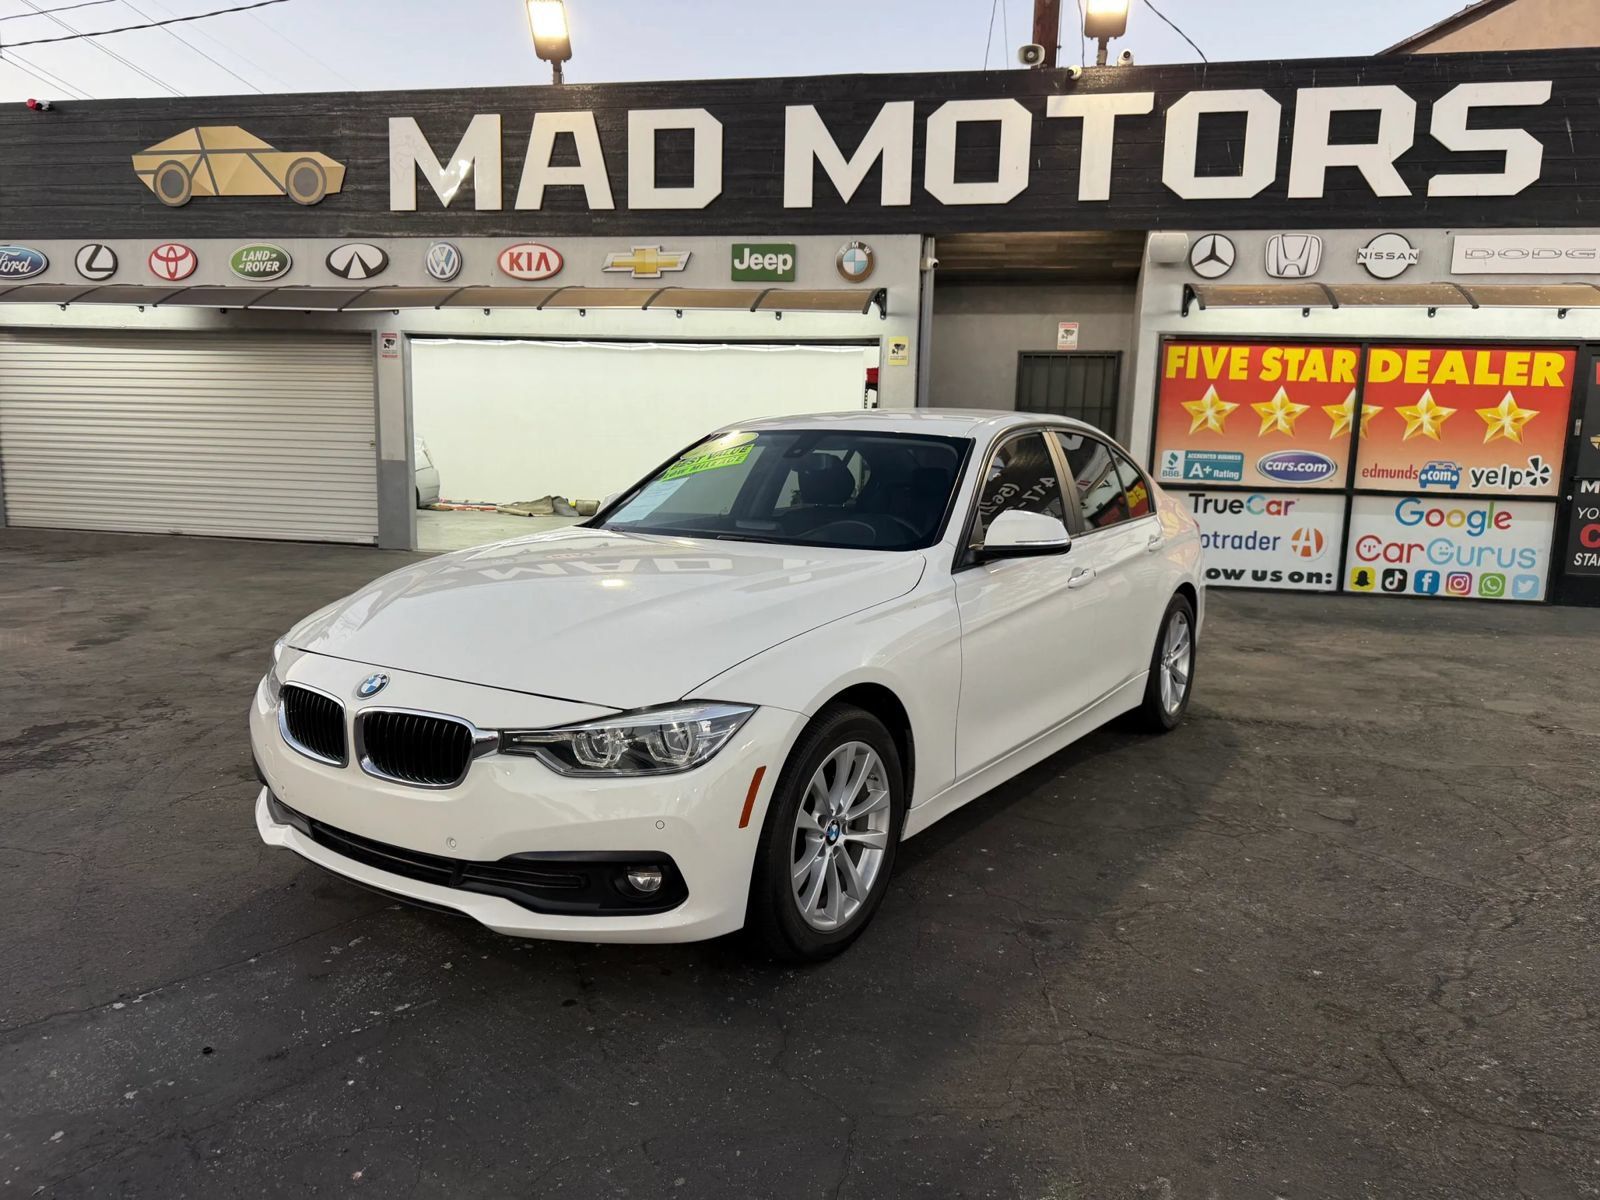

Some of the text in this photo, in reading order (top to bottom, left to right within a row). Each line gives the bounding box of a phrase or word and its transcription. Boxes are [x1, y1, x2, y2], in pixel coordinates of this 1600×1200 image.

[389, 80, 1553, 211] MAD MOTORS
[241, 250, 269, 262] LAND
[508, 253, 552, 272] KIA
[734, 248, 793, 275] Jeep
[1357, 250, 1419, 261] NISSAN
[244, 260, 280, 272] ROVER
[1165, 345, 1251, 381] FIVE
[1259, 347, 1358, 384] STAR
[1368, 350, 1566, 388] DEALER
[1188, 462, 1240, 480] A+ Rating
[1265, 460, 1328, 473] cars.com
[1362, 463, 1419, 480] edmunds
[1470, 465, 1523, 490] yelp
[1188, 493, 1296, 516] TrueCar
[1577, 506, 1600, 520] YO
[1395, 496, 1513, 537] Google
[1355, 534, 1537, 569] CarGurus
[1573, 552, 1600, 567] STA
[1251, 569, 1283, 583] us
[1287, 571, 1333, 584] on:
